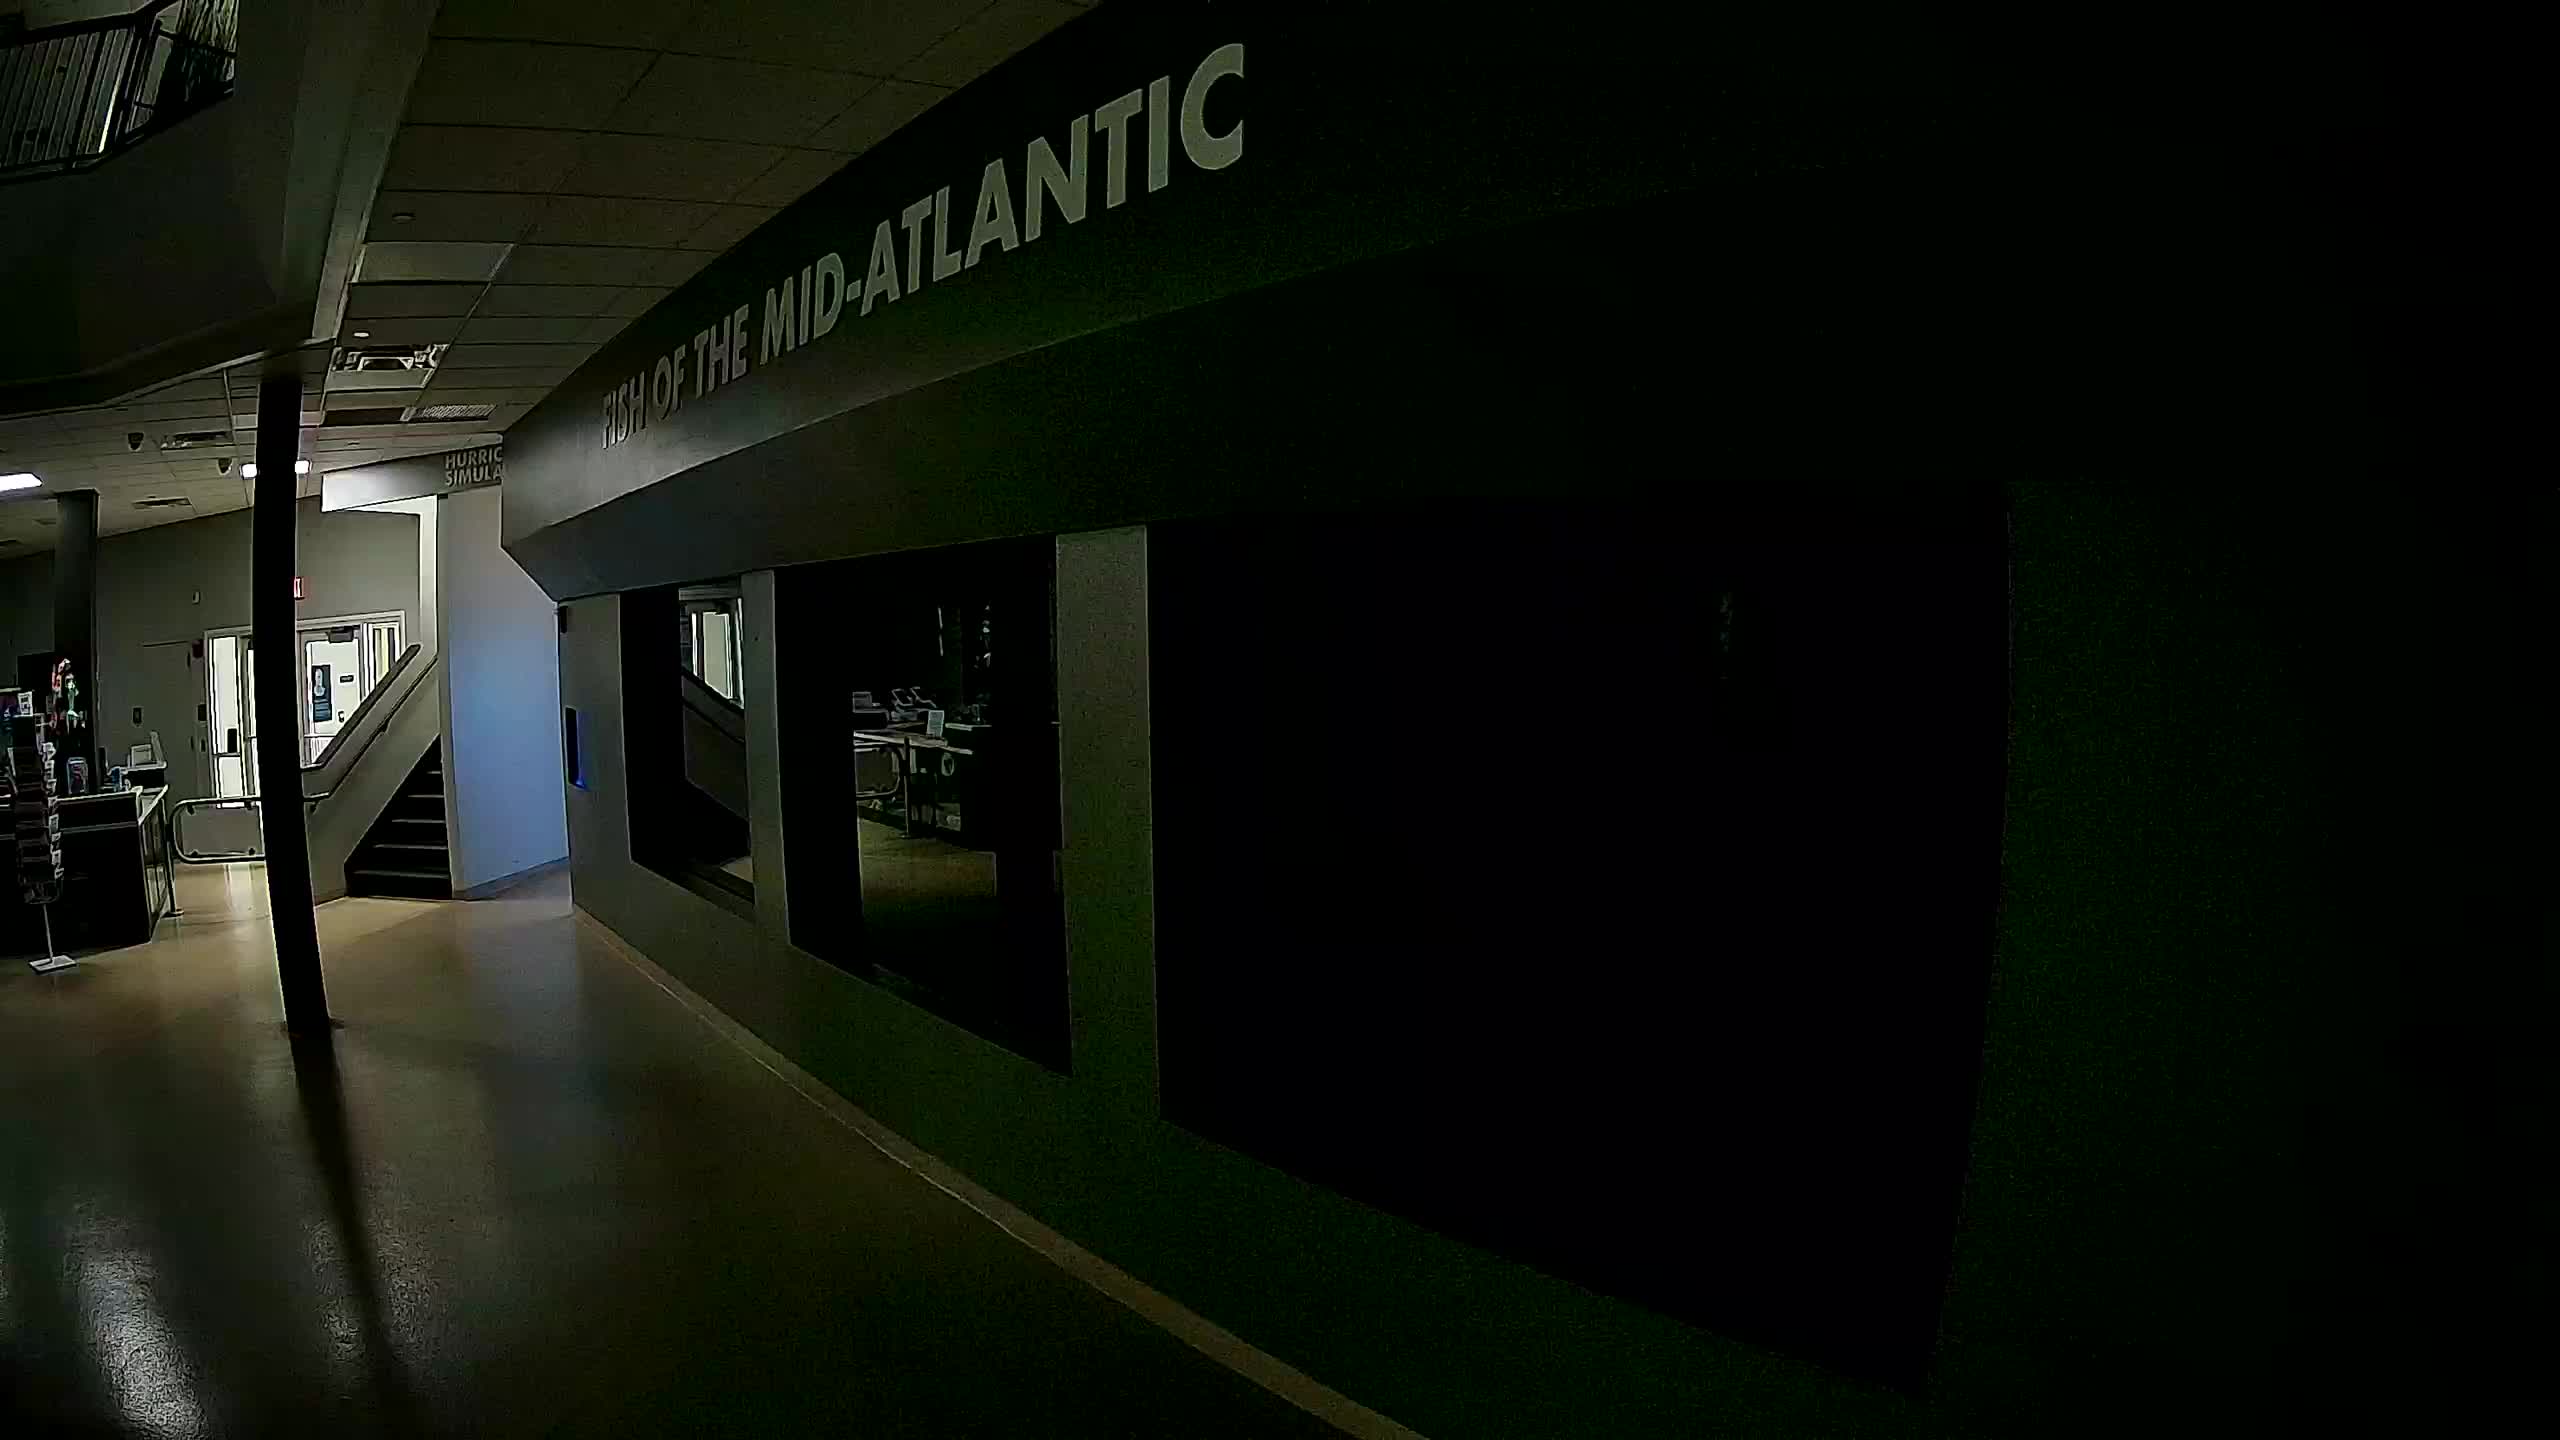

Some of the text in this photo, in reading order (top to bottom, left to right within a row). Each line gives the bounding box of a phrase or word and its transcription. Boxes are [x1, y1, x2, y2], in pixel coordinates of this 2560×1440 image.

[602, 43, 1244, 450] FISH OF THE MID-ATLANTIC
[445, 446, 503, 470] HURRIC
